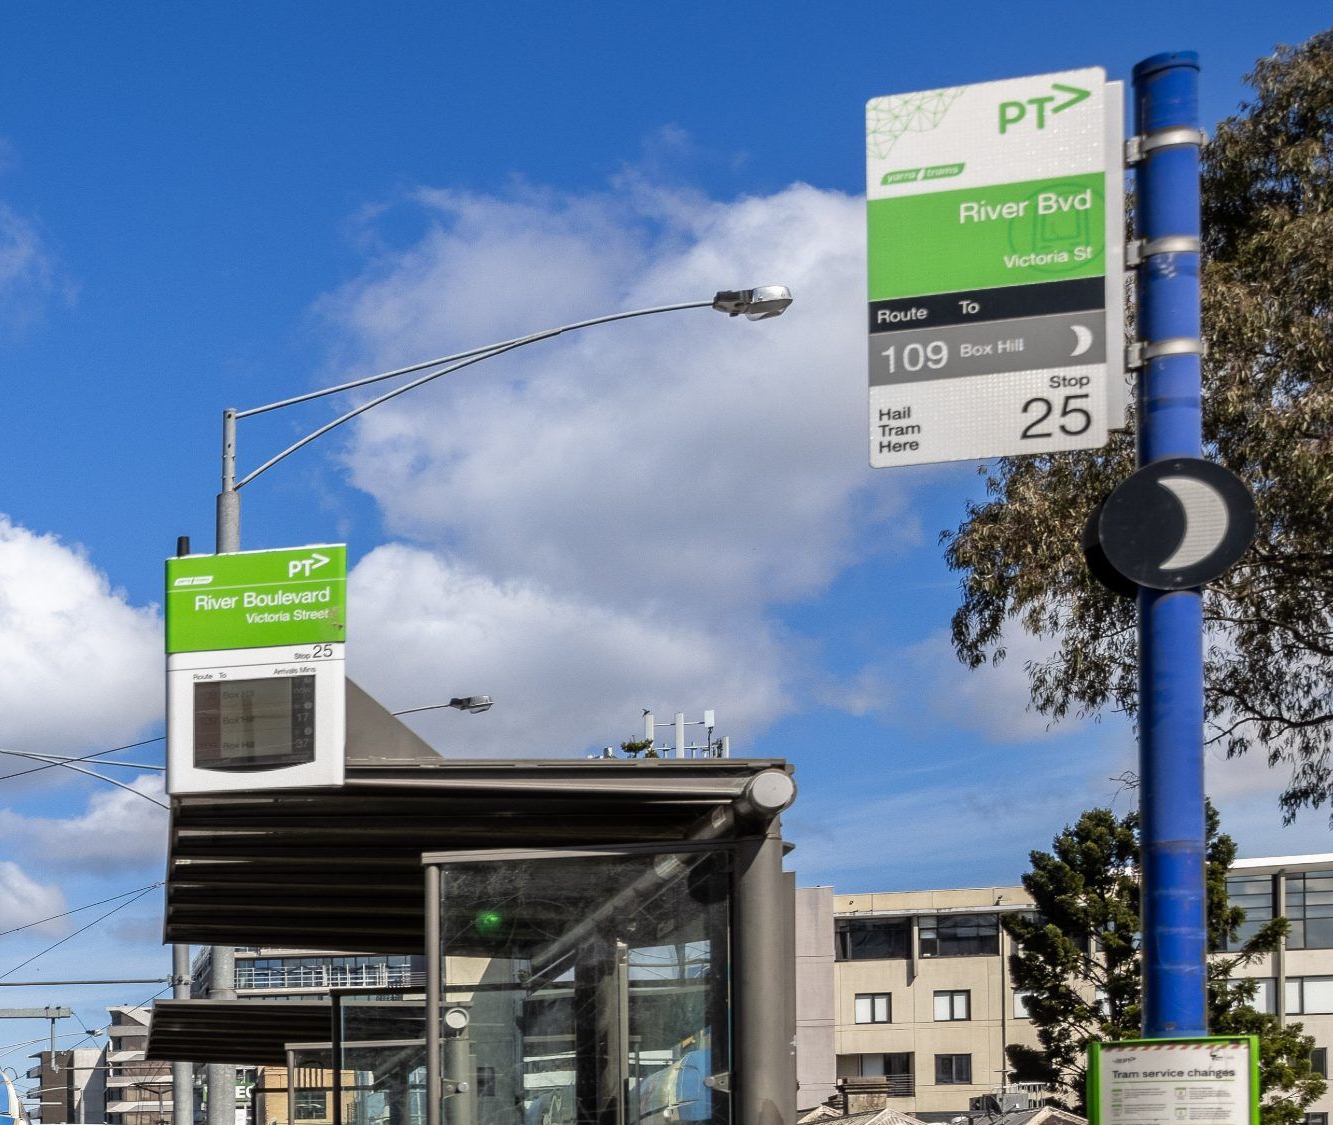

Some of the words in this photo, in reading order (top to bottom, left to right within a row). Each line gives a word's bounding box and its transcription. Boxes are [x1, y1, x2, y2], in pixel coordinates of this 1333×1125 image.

[926, 165, 959, 179] trams
[959, 201, 1028, 224] River
[1038, 189, 1092, 215] Bvd
[1003, 250, 1068, 268] Victoria
[1074, 246, 1093, 261] St
[877, 308, 928, 323] Route
[959, 300, 980, 314] To
[881, 340, 948, 373] 109
[960, 343, 993, 358] Box
[998, 338, 1024, 353] Hill
[1049, 375, 1090, 389] Stop
[879, 406, 911, 421] Hail
[1020, 393, 1092, 440] 25
[879, 423, 921, 437] Tram
[879, 441, 920, 453] Here
[195, 594, 238, 611] River
[243, 586, 330, 608] Boulevard
[246, 612, 290, 624] Victoria
[293, 609, 329, 621] Street
[294, 652, 311, 660] Stop
[312, 643, 333, 659] 25
[1112, 1070, 1139, 1078] Tram
[1142, 1069, 1184, 1078] service
[1188, 1068, 1235, 1079] changes
